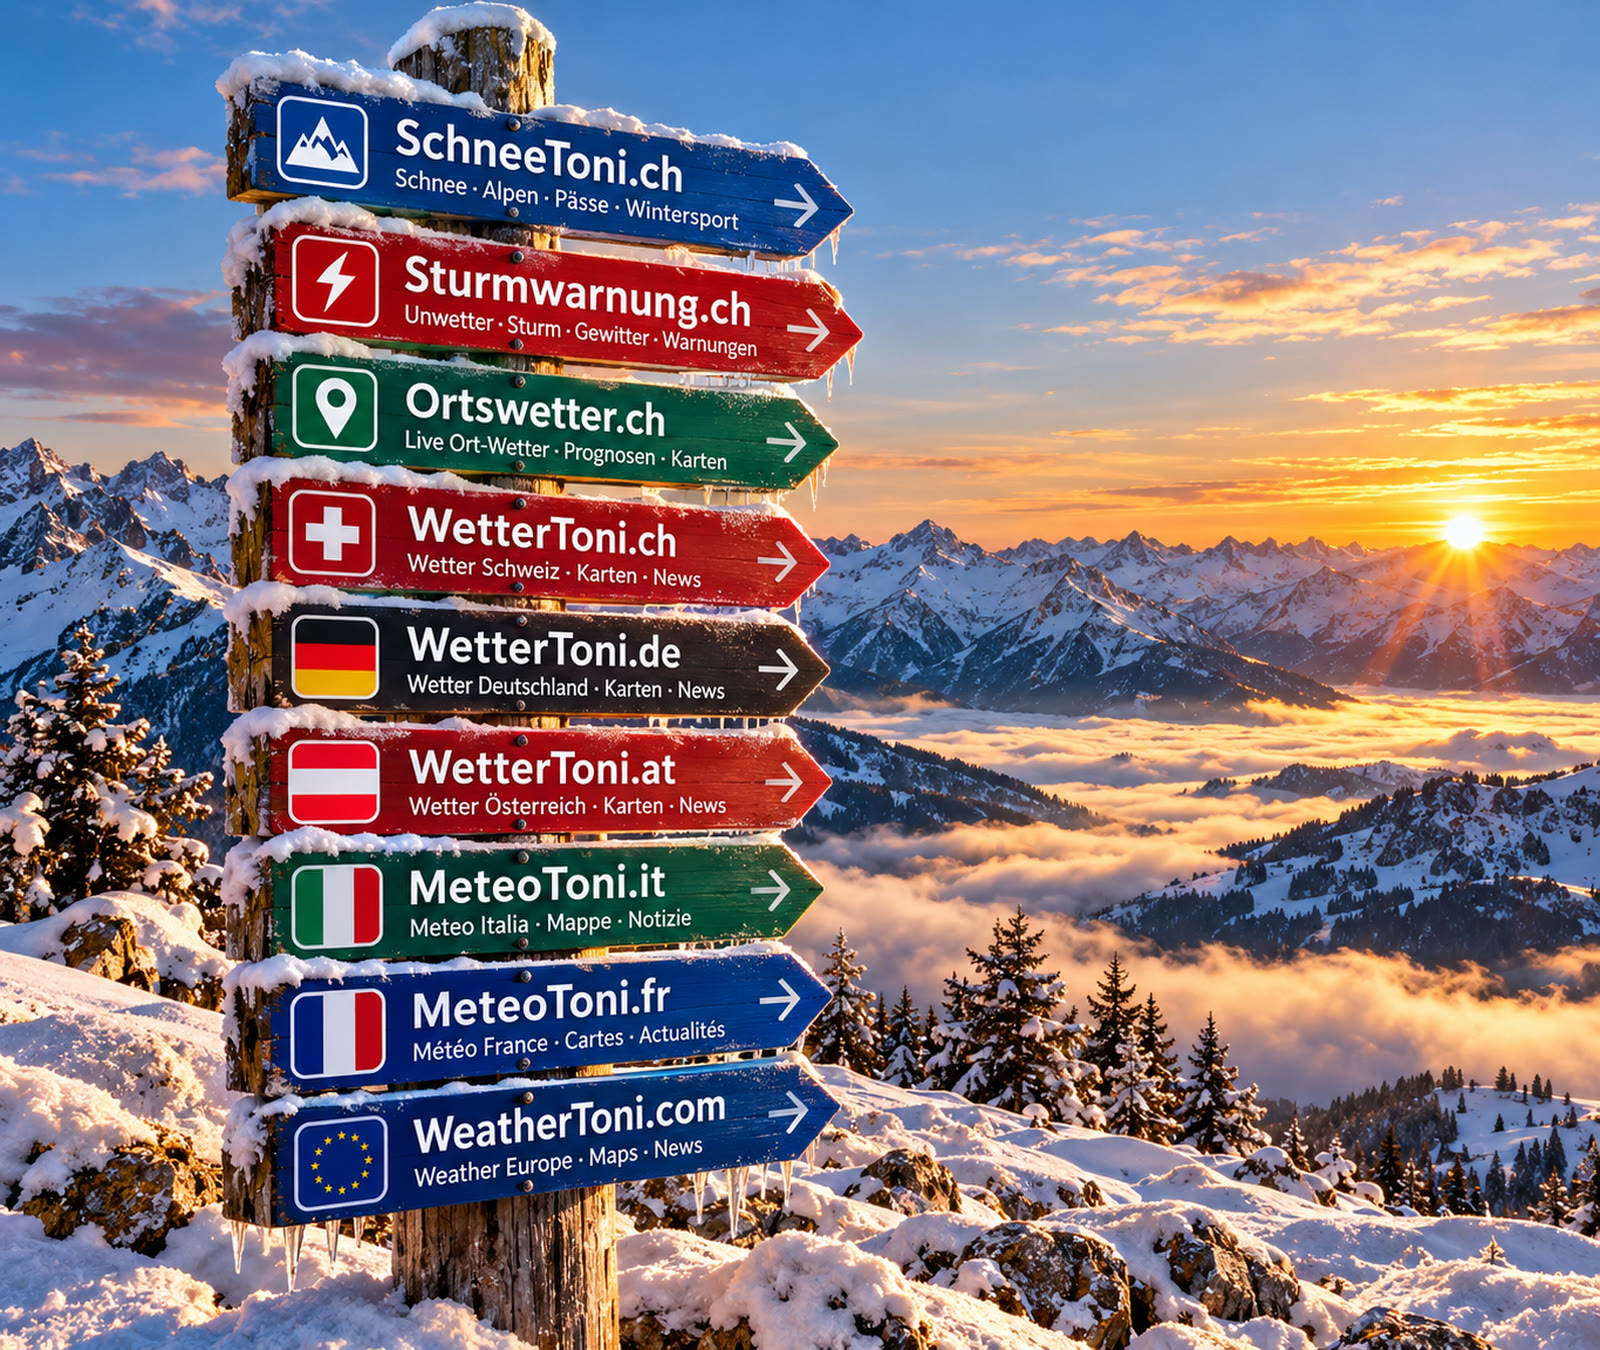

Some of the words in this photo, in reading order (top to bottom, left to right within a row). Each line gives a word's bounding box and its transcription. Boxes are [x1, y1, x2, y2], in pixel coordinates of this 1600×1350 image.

[395, 118, 683, 193] SchneeToni.ch
[395, 167, 468, 196] Schnee
[482, 180, 539, 207] Alpen
[555, 188, 609, 214] Pässe
[625, 198, 739, 231] Wintersport
[404, 254, 751, 330] Sturmwarnung.ch
[405, 304, 495, 332] Unwetter
[507, 315, 561, 338] Sturm
[574, 321, 650, 347] Gewitter
[662, 330, 757, 360] Warnungen
[406, 382, 665, 437] Ortswetter.ch
[405, 429, 444, 451] Live
[449, 433, 550, 458] Ort-Wetter
[564, 441, 656, 467] Prognosen
[671, 449, 727, 471] Karten
[407, 505, 676, 558] WetterToni.ch
[407, 553, 477, 576] Wetter
[482, 557, 560, 580] Schweiz
[577, 563, 637, 584] Karten
[653, 567, 702, 588] News
[406, 625, 681, 669] WetterToni.de
[406, 673, 474, 695] Wetter
[478, 675, 588, 697] Deutschland
[605, 678, 662, 698] Karten
[678, 680, 726, 700] News
[408, 749, 676, 785] WetterToni.at
[408, 796, 480, 816] Wetter
[485, 792, 586, 816] Österreich
[604, 796, 664, 815] Karten
[679, 796, 727, 814] News
[410, 862, 666, 905] MeteoToni.it
[410, 917, 475, 938] Meteo
[481, 913, 529, 935] Italia
[547, 913, 612, 936] Mappe
[628, 908, 692, 929] Notizie
[412, 976, 671, 1029] MeteoToni.fr
[413, 1038, 478, 1062] Météo
[484, 1036, 548, 1057] France
[565, 1030, 624, 1050] Cartes
[639, 1019, 726, 1044] Actualités
[413, 1094, 726, 1155] WeatherToni.com
[414, 1161, 501, 1188] Weather
[506, 1155, 573, 1177] Europe
[589, 1146, 639, 1168] Maps
[654, 1139, 703, 1159] News
